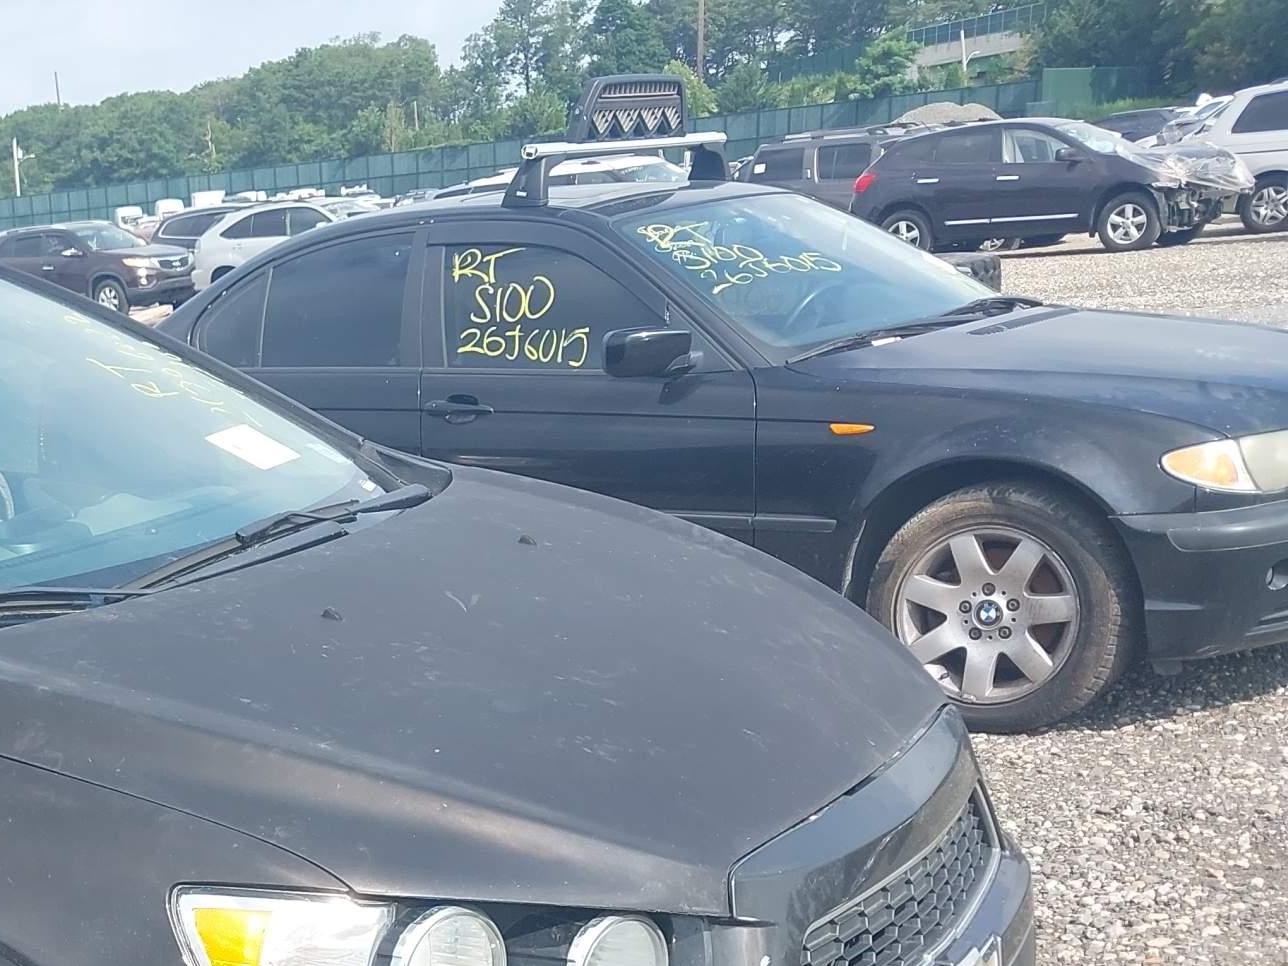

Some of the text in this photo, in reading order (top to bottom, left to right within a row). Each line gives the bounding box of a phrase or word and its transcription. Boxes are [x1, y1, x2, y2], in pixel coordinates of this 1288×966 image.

[452, 247, 526, 283] RT
[470, 275, 555, 323] S100
[457, 324, 590, 367] 26J6015
